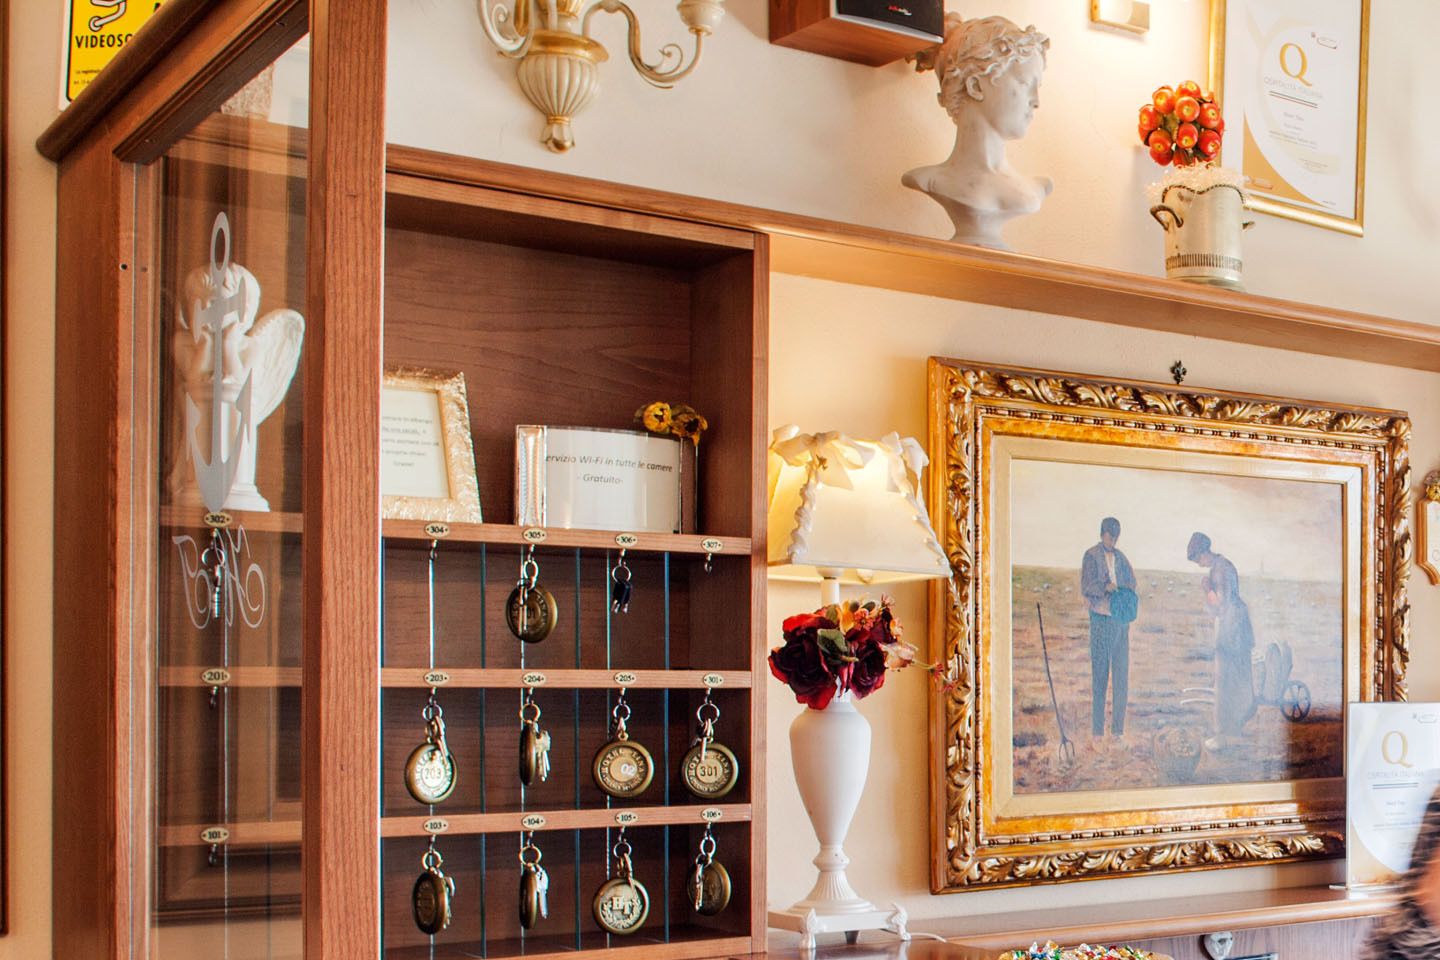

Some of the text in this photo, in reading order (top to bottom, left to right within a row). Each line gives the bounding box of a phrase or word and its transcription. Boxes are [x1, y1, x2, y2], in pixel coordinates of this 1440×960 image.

[1280, 42, 1312, 87] Q
[545, 454, 576, 464] ervizio
[647, 463, 673, 473] camere
[1381, 730, 1414, 768] Q
[700, 765, 718, 777] 301
